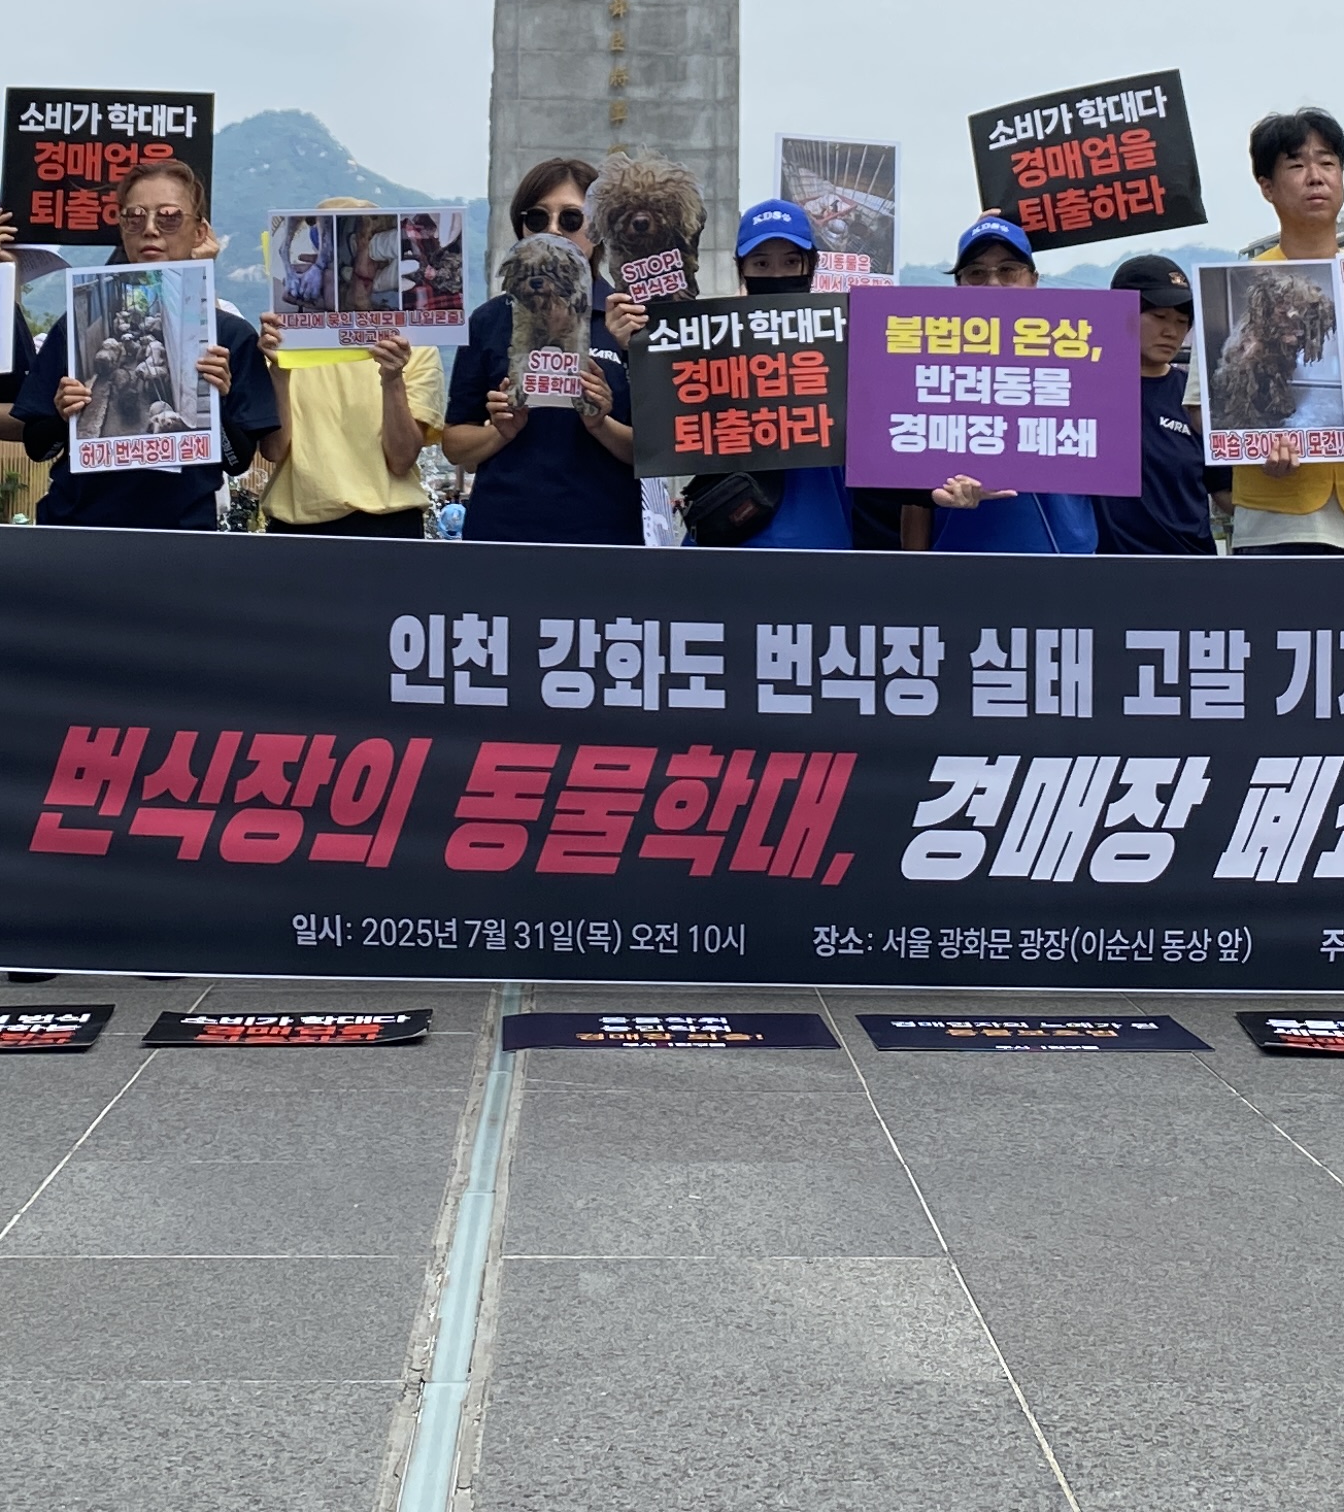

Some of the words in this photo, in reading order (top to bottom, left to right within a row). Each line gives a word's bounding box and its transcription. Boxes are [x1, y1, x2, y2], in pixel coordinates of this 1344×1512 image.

[19, 102, 102, 135] 소비가
[107, 103, 197, 138] 학대다
[988, 104, 1073, 150] 소비가
[1076, 86, 1167, 128] 학대다
[1010, 128, 1156, 188] 경매업을
[752, 210, 781, 225] KDS
[1017, 175, 1166, 233] 퇴출하라
[622, 249, 683, 282] STOP!
[816, 252, 870, 272] 기동물은
[630, 272, 687, 302] 번식장!
[648, 311, 743, 352] 소비가
[748, 307, 846, 345] 학대다
[886, 315, 1000, 355] 불법의
[1013, 317, 1102, 362] 온상,
[529, 352, 579, 372] STOP!
[589, 348, 622, 365] KARA
[524, 374, 581, 395] 동물학대!
[672, 350, 829, 403] 경매업을
[915, 364, 1071, 406] 반려동물
[674, 403, 834, 455] 퇴출하라
[889, 413, 1007, 454] 경매장
[1017, 417, 1097, 458] 폐쇄
[1159, 416, 1191, 435] KARA
[80, 443, 111, 467] 허가
[115, 438, 175, 465] 번식장의
[179, 435, 211, 460] 실체
[1210, 432, 1240, 459] 펫숍
[389, 612, 509, 706] 인천
[538, 615, 726, 711] 강화도
[757, 623, 946, 716] 번식장
[970, 626, 1093, 719] 실태
[1123, 627, 1251, 720] 고발
[29, 725, 433, 870] 번식장의
[443, 739, 857, 885] 동물학대,
[898, 752, 1212, 884] 경매장
[292, 914, 352, 947] 일시:
[361, 917, 459, 950] 2025년
[463, 918, 507, 951] 7월
[513, 919, 622, 955] 31일(목)
[629, 921, 678, 953] 오전
[689, 923, 746, 956] 10시
[813, 924, 873, 959] 장소:
[881, 927, 933, 960] 서울
[937, 927, 1011, 961] 광화문
[1018, 926, 1154, 964] 광장(이순신
[1161, 927, 1212, 963] 동상
[1216, 926, 1253, 964] 앞)
[18, 1012, 92, 1023] 번식
[180, 1014, 293, 1026] 소비가
[300, 1013, 411, 1025] 학대다
